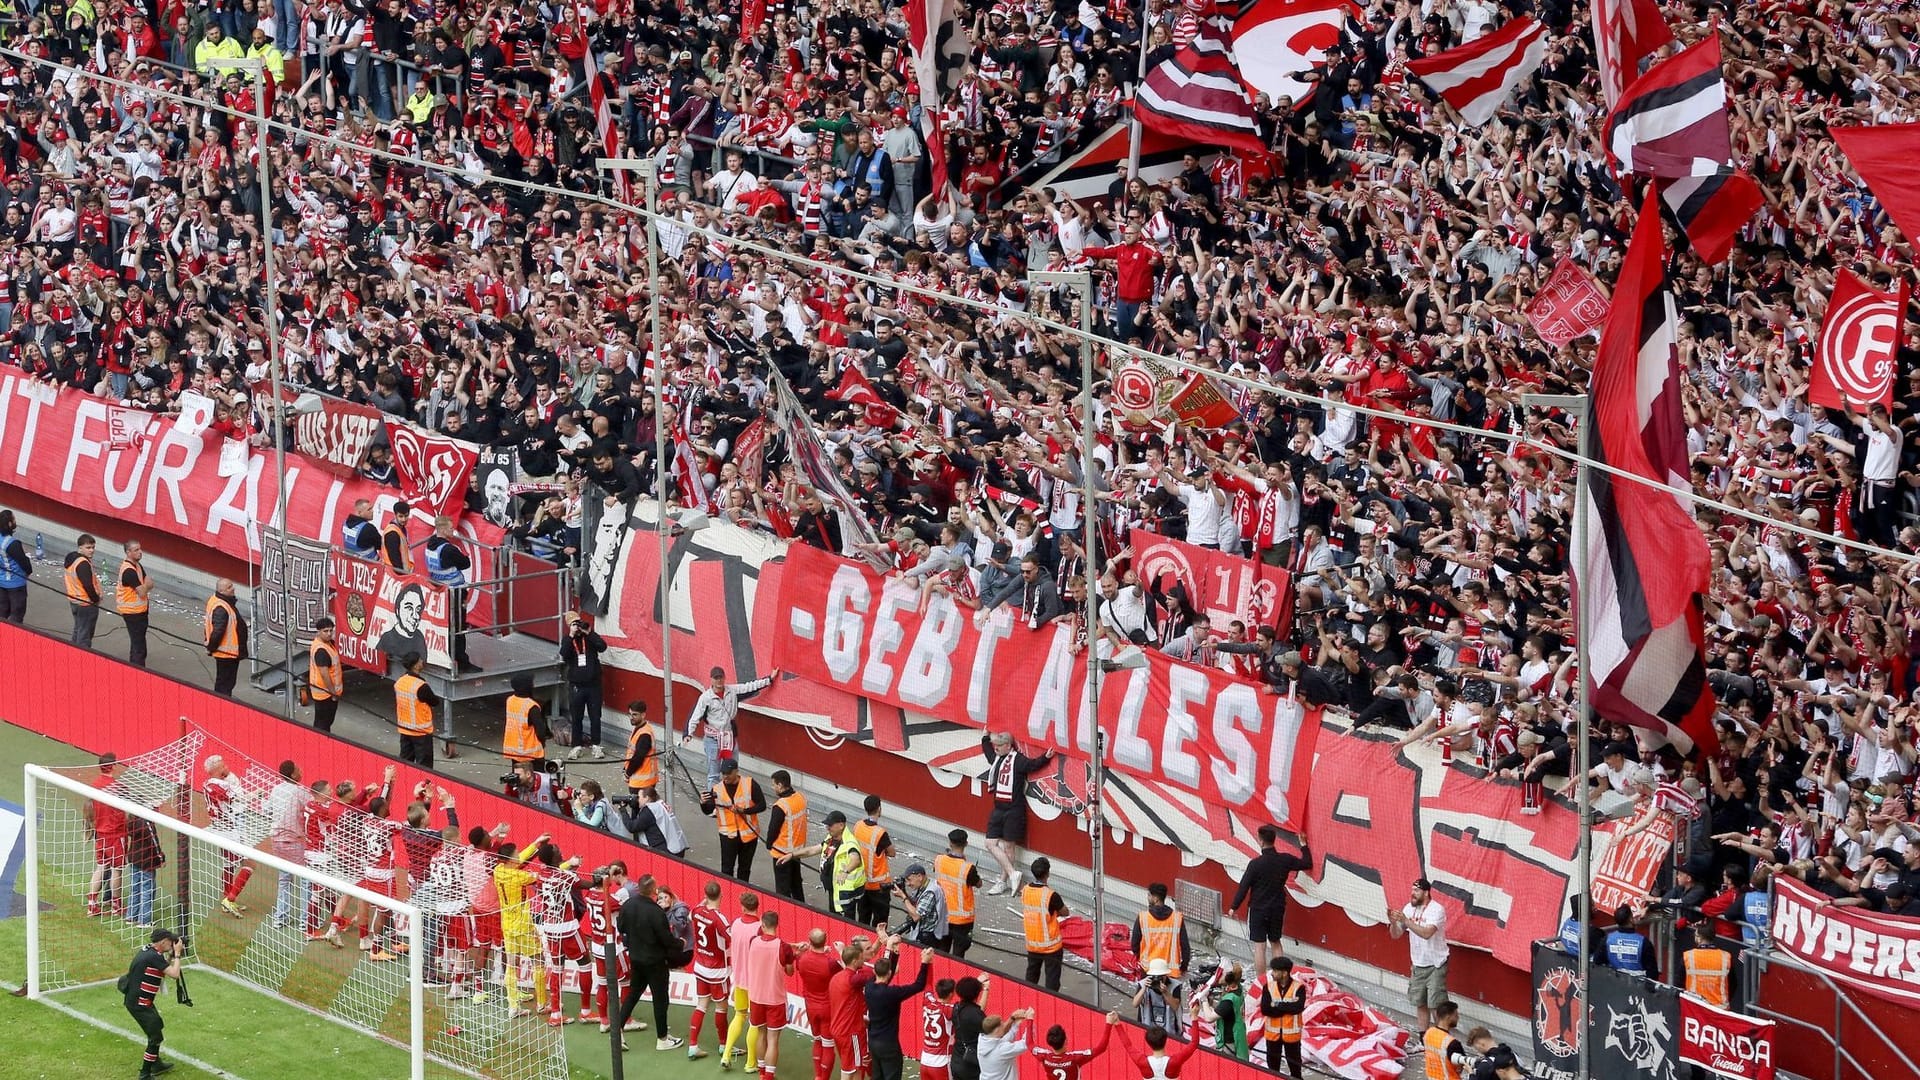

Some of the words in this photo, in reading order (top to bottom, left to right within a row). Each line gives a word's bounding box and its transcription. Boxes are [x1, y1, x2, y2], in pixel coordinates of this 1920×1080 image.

[497, 454, 510, 465] 85
[265, 547, 322, 593] VECHIO
[337, 557, 378, 595] ULTRAS
[378, 571, 446, 620] UNTED
[1027, 622, 1304, 826] ALLES!
[696, 920, 708, 948] 3
[922, 1008, 943, 1040] 23
[1684, 1016, 1770, 1069] BANDA
